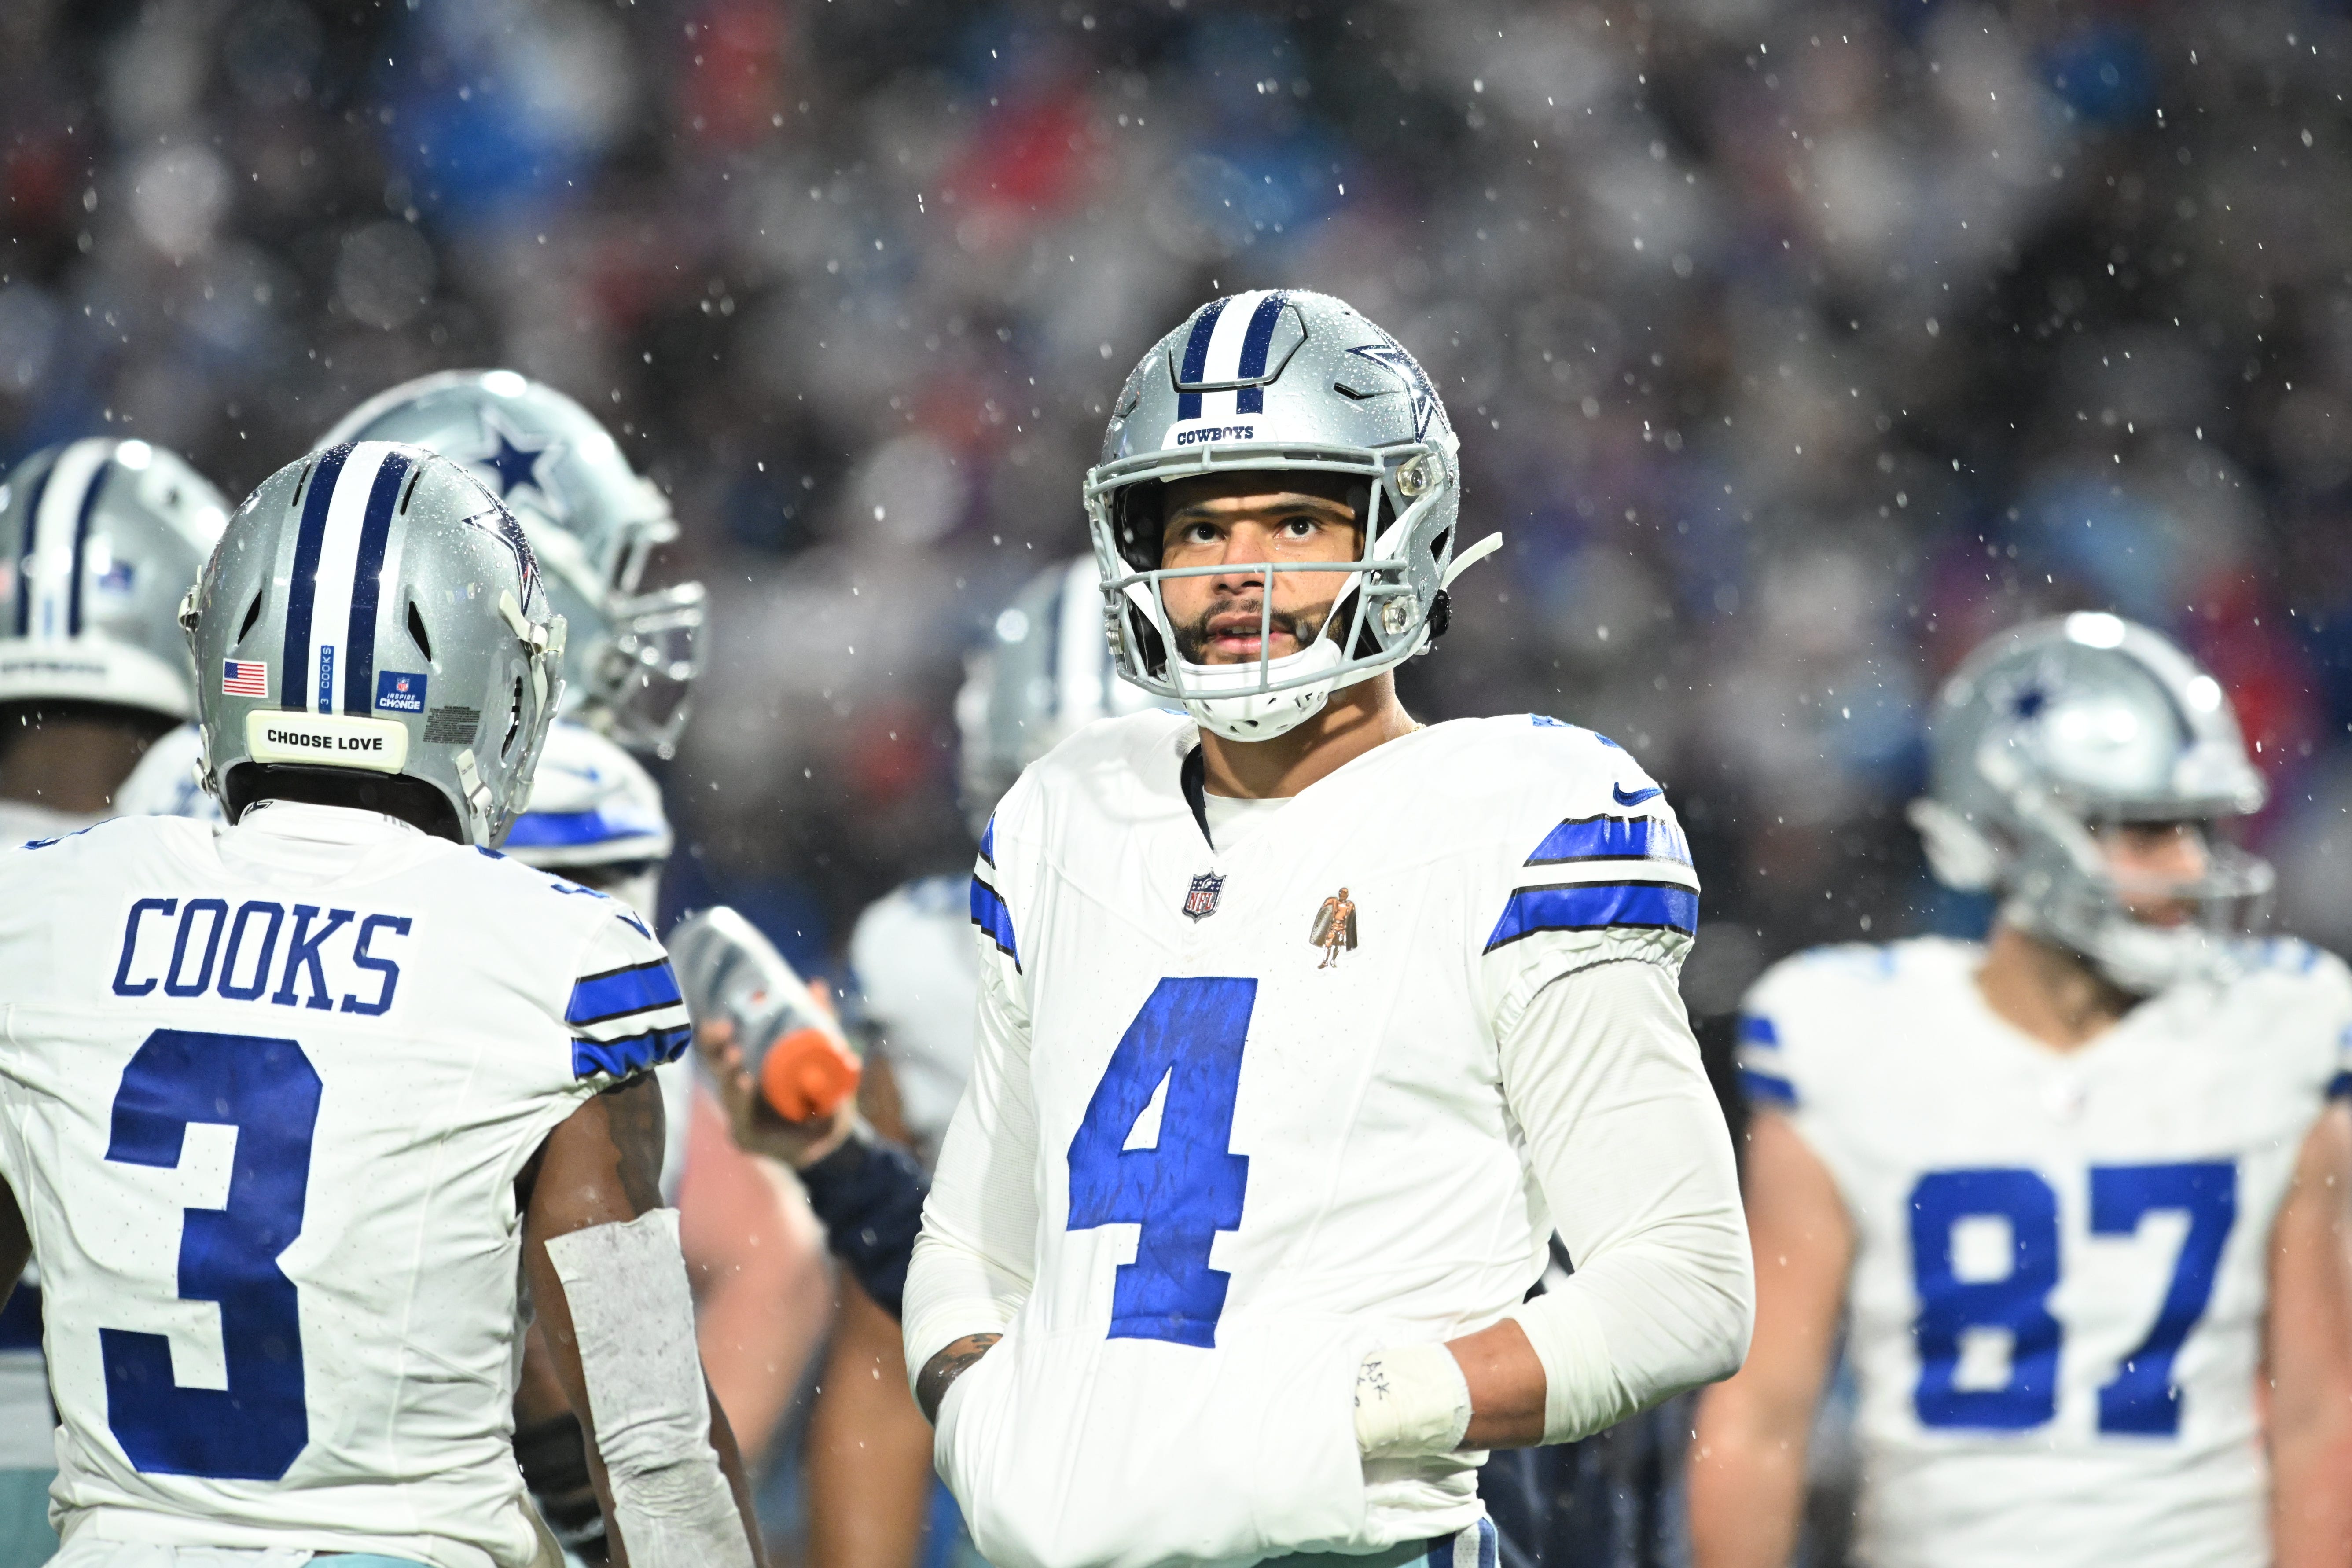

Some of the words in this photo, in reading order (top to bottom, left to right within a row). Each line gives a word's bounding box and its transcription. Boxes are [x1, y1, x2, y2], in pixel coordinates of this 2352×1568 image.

[1177, 426, 1254, 445] COWBOYS
[321, 647, 331, 689] COOKS
[379, 698, 421, 710] CHANGE
[387, 692, 415, 701] INSPIRE
[268, 729, 332, 749] CHOOSE
[338, 738, 382, 750] LOVE
[1188, 892, 1213, 911] NFL
[112, 898, 413, 1016] COOKS
[1066, 976, 1258, 1348] 4
[99, 1028, 323, 1481] 3
[1905, 1160, 2240, 1436] 87
